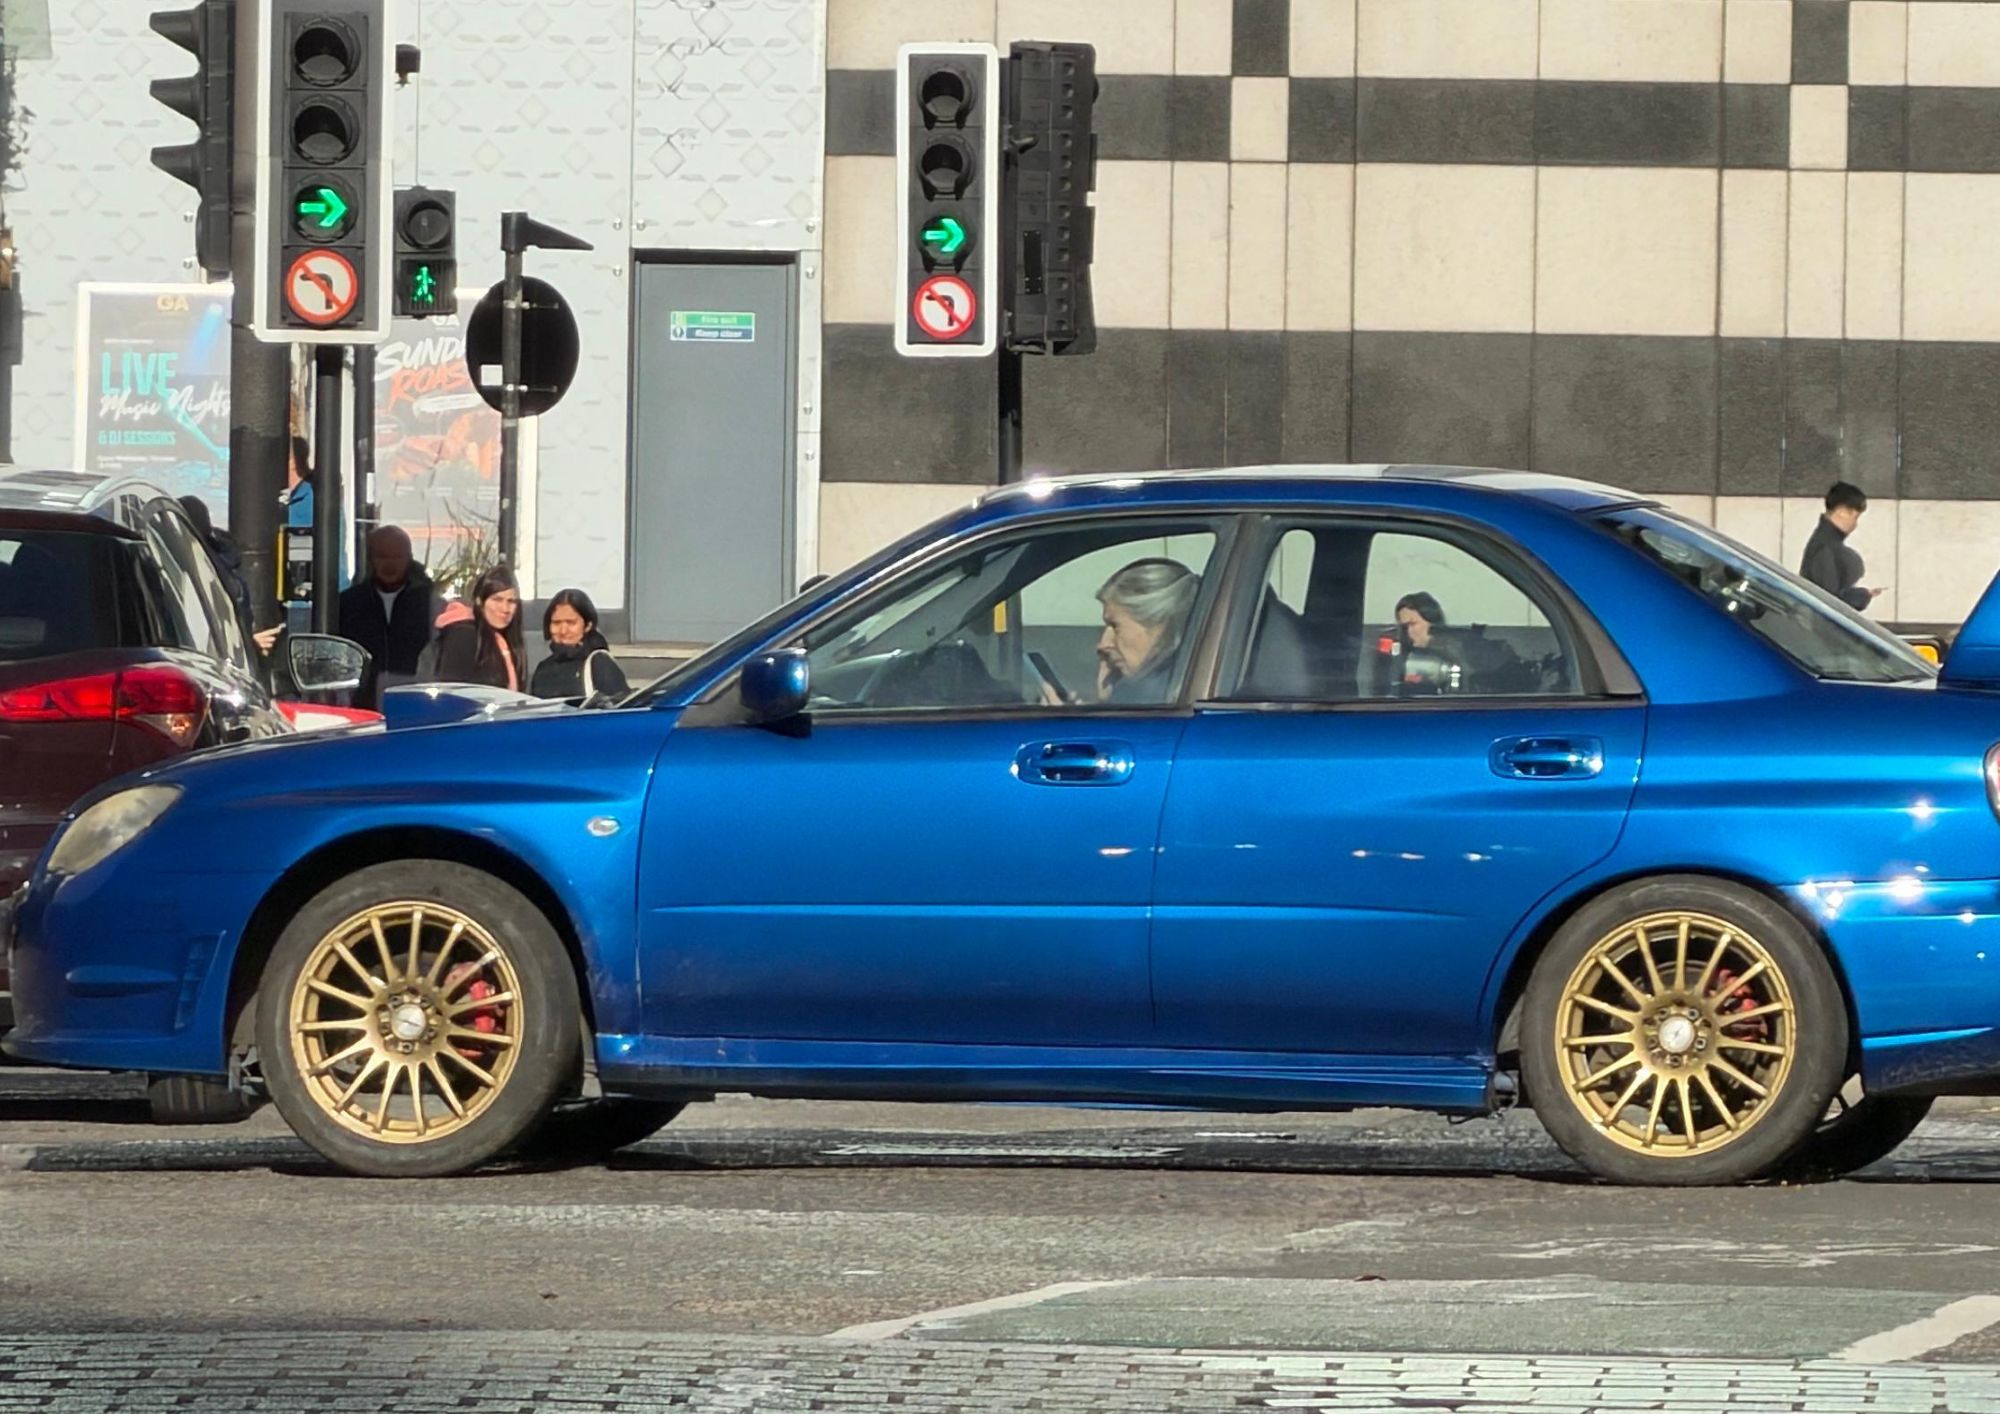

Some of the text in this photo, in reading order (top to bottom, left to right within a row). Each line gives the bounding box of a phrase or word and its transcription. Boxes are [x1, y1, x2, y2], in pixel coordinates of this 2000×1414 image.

[156, 293, 189, 312] GA
[102, 351, 178, 396] LIVE
[374, 336, 466, 381] SUND
[99, 386, 160, 421] Music
[387, 357, 470, 412] ROAS
